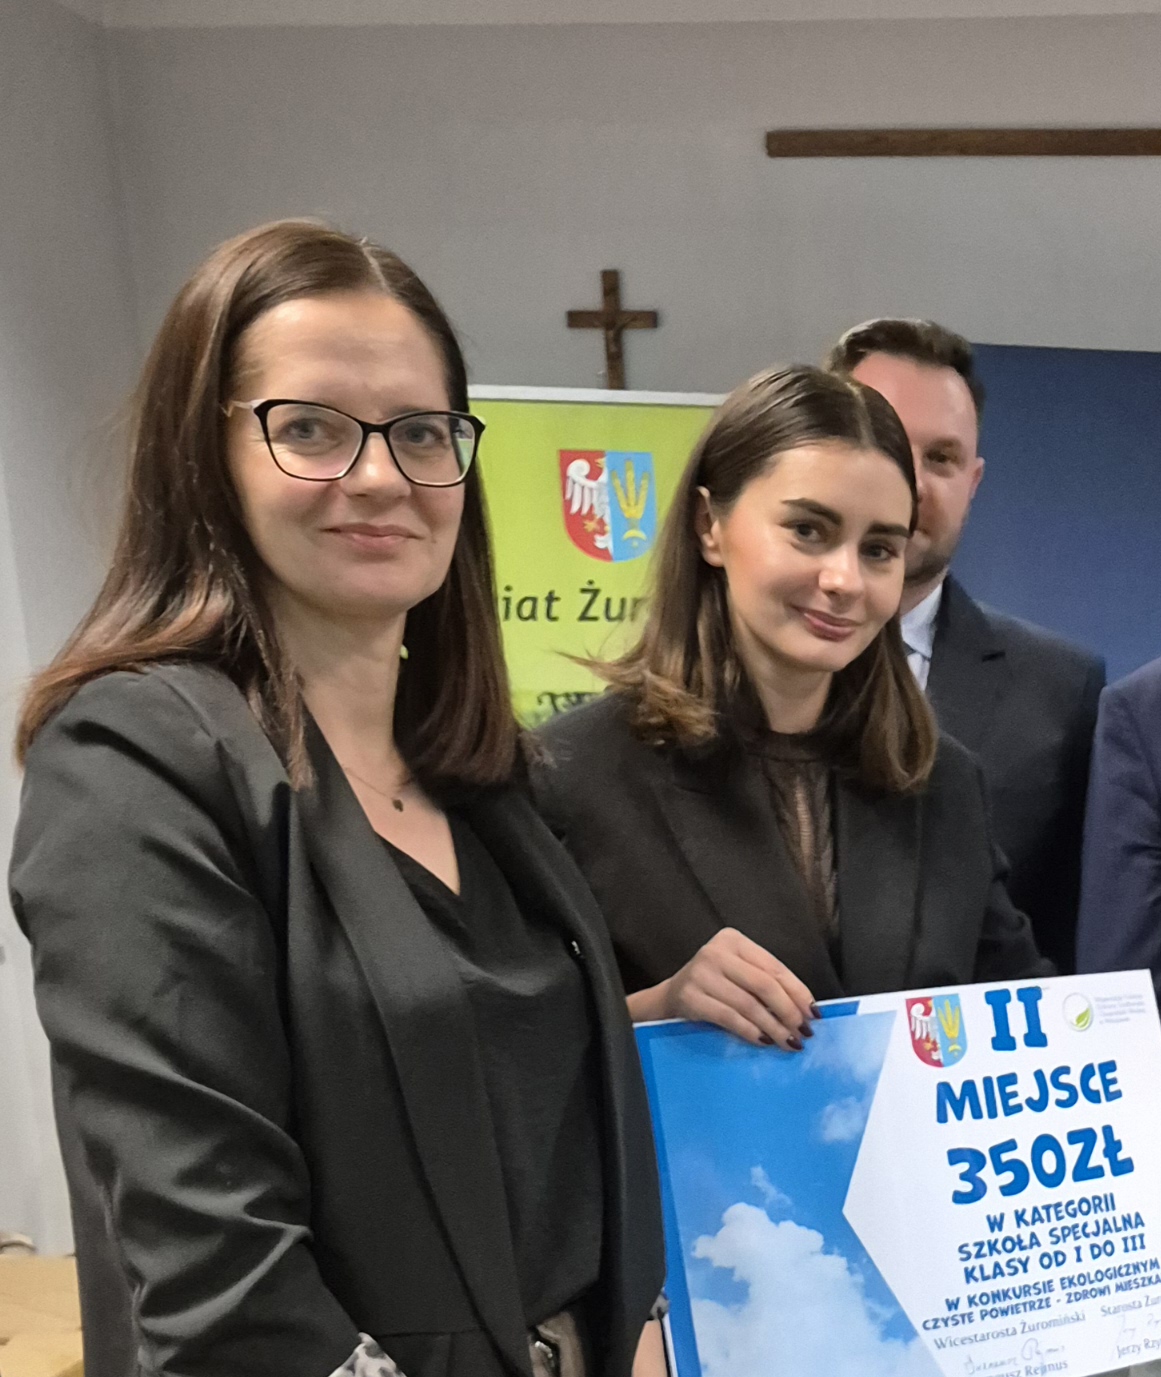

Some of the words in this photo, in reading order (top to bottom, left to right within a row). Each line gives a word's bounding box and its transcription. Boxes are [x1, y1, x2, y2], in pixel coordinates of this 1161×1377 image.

[502, 585, 561, 622] iat
[984, 986, 1048, 1051] II
[936, 1059, 1123, 1124] MIEJSCE
[946, 1124, 1135, 1205] 350ZŁ
[958, 1231, 1041, 1262] SZKOŁA
[1049, 1211, 1145, 1246] SPECJALNA
[986, 1212, 1005, 1233] W
[1014, 1192, 1116, 1229] KATEGORII
[945, 1297, 961, 1312] W
[967, 1279, 1054, 1309] KONKURSIE
[1060, 1257, 1161, 1290] EKOLOGICZNYM
[963, 1255, 1030, 1285] KLASY
[1039, 1250, 1067, 1270] OD
[1075, 1245, 1084, 1263] I
[1091, 1240, 1115, 1261] DO
[1122, 1233, 1147, 1253] III
[922, 1308, 975, 1331] CZYSTE
[980, 1297, 1052, 1321] POWIETRZE
[1065, 1285, 1111, 1304] ZDROWI
[934, 1326, 1018, 1350] Wicestarosta
[1020, 1310, 1086, 1335] Żuromiński
[1101, 1297, 1143, 1317] Starosta
